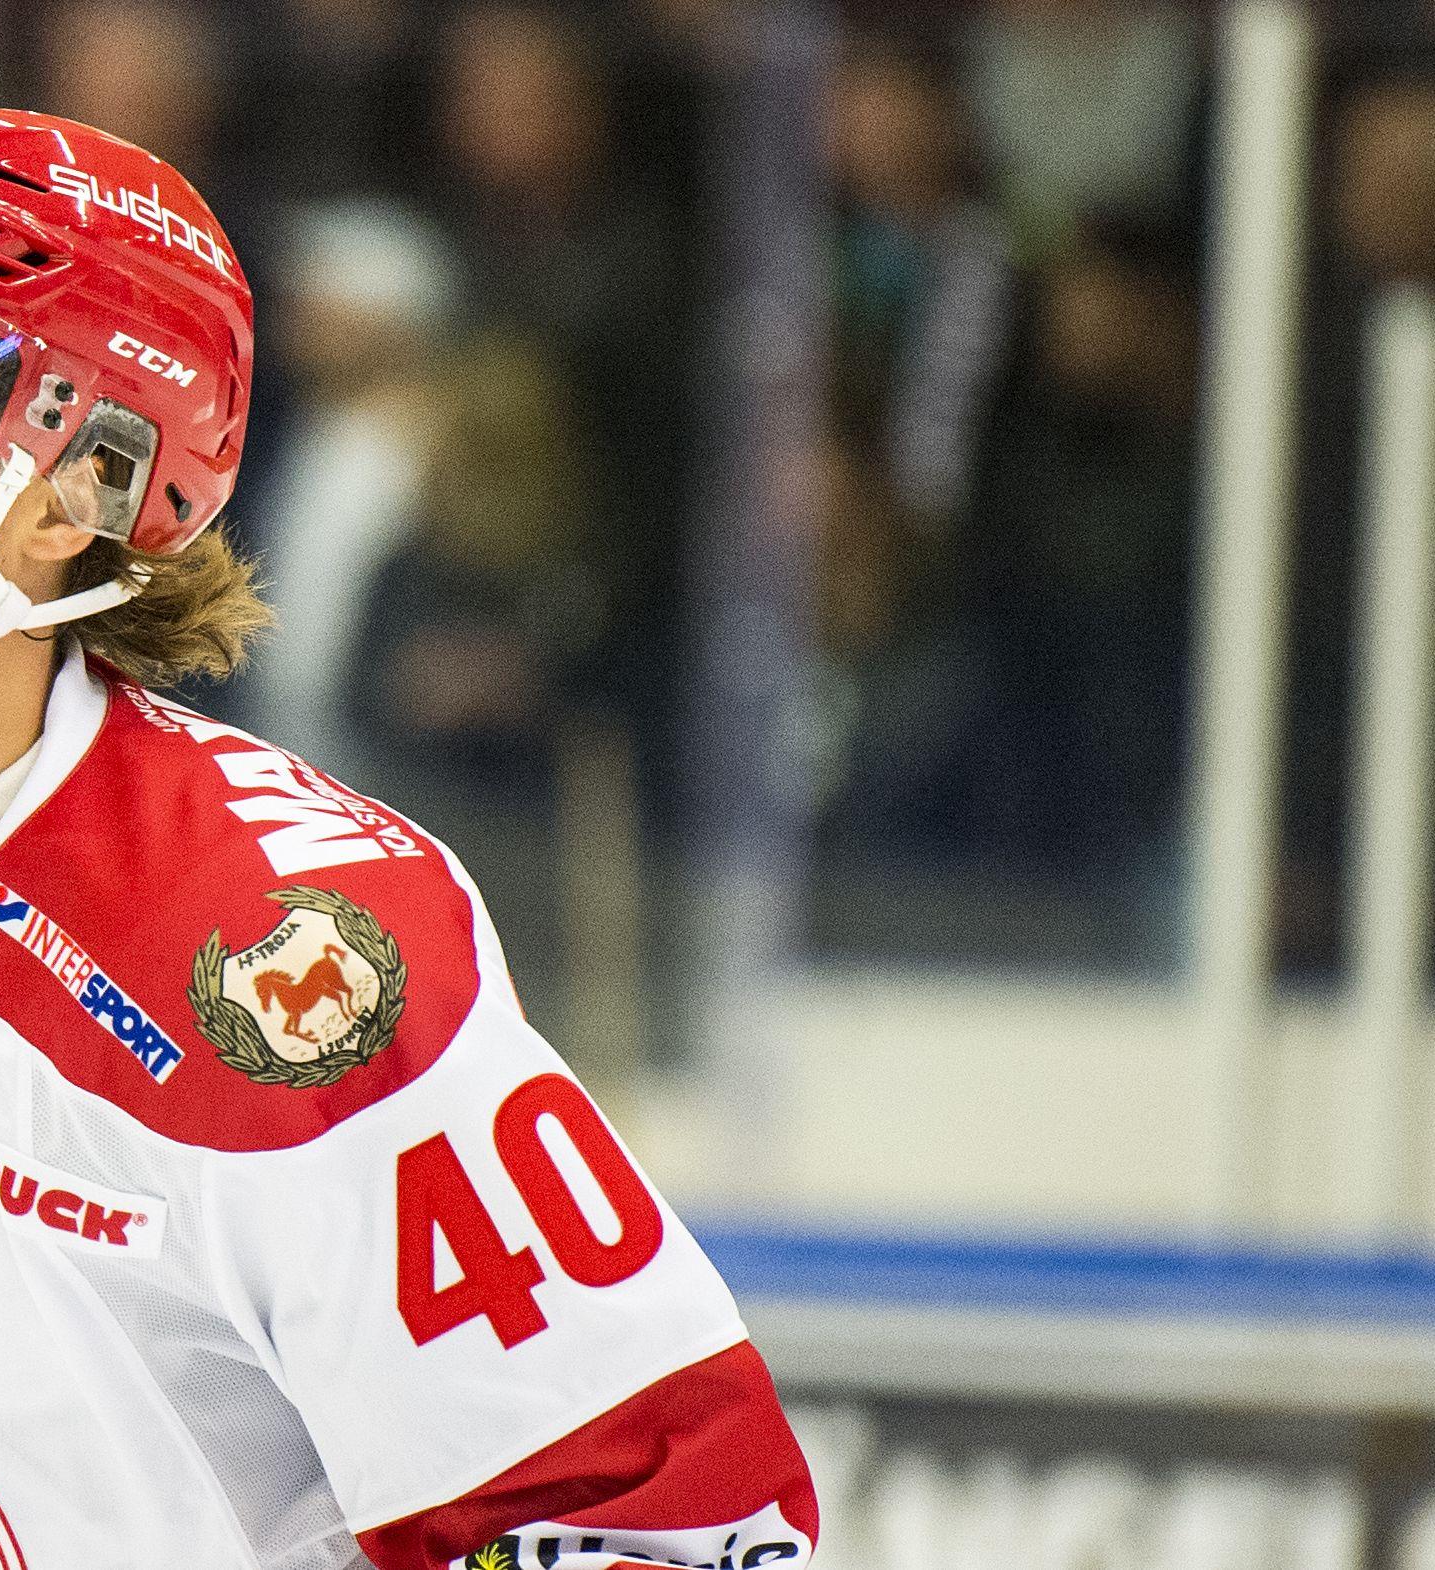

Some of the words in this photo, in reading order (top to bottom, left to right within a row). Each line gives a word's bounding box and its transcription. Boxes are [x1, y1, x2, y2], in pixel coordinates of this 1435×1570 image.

[107, 330, 198, 388] CCM
[20, 911, 191, 1077] INTERSPORT
[397, 1073, 664, 1350] 40
